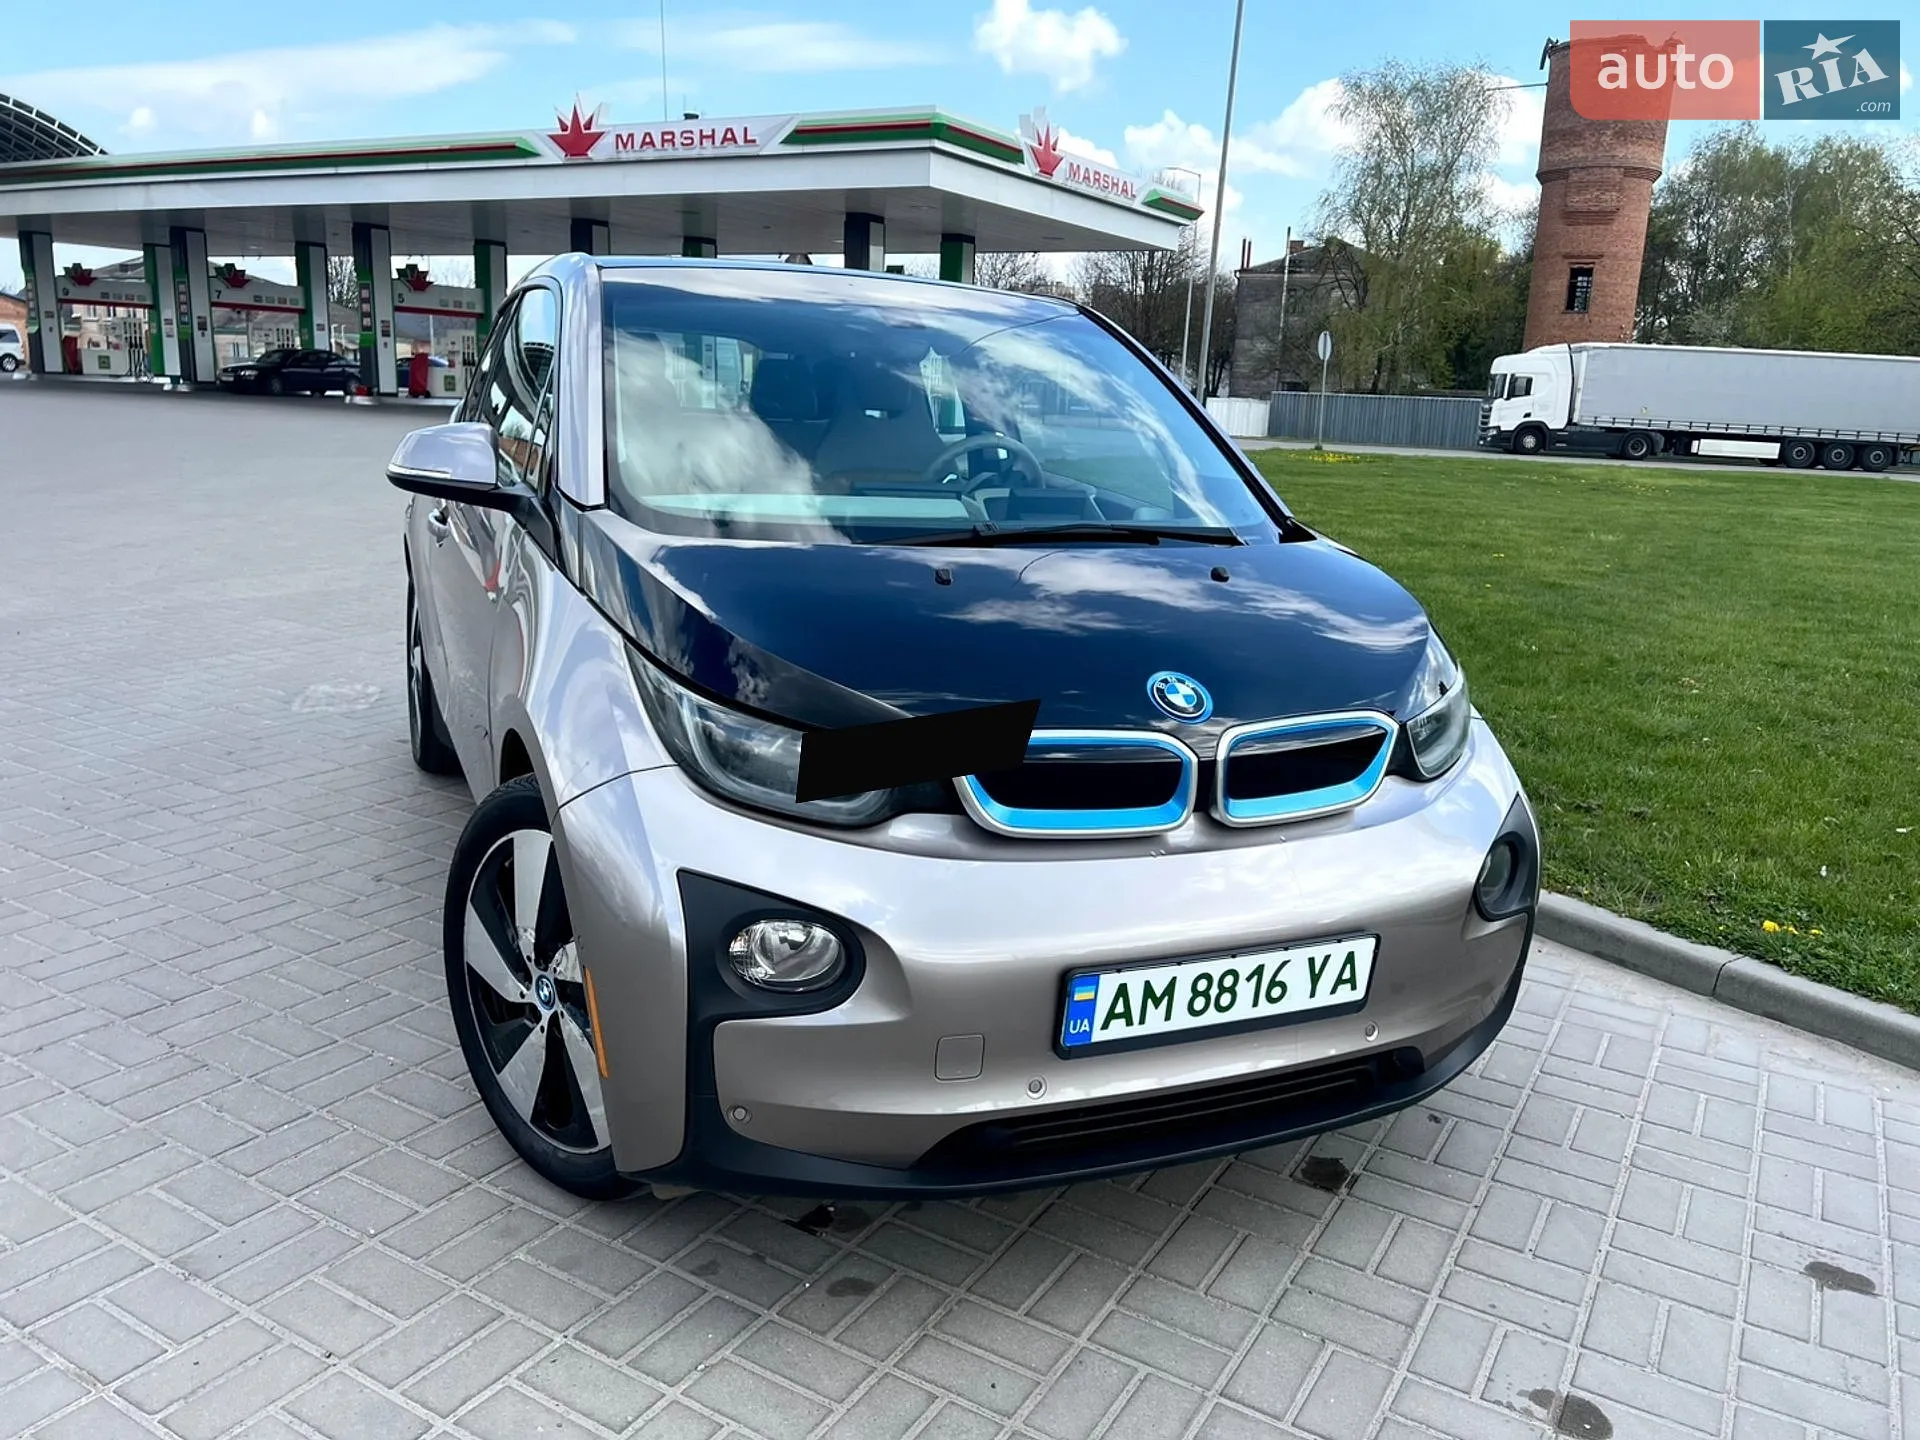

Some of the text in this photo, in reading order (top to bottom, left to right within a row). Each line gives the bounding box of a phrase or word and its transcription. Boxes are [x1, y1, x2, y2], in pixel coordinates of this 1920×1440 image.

[615, 126, 757, 150] MARSHAL
[1068, 162, 1137, 198] MARSHAL
[215, 290, 222, 299] 7
[398, 293, 405, 303] 5
[1100, 950, 1358, 1030] AM 8816 YA
[1069, 1017, 1090, 1034] UA
